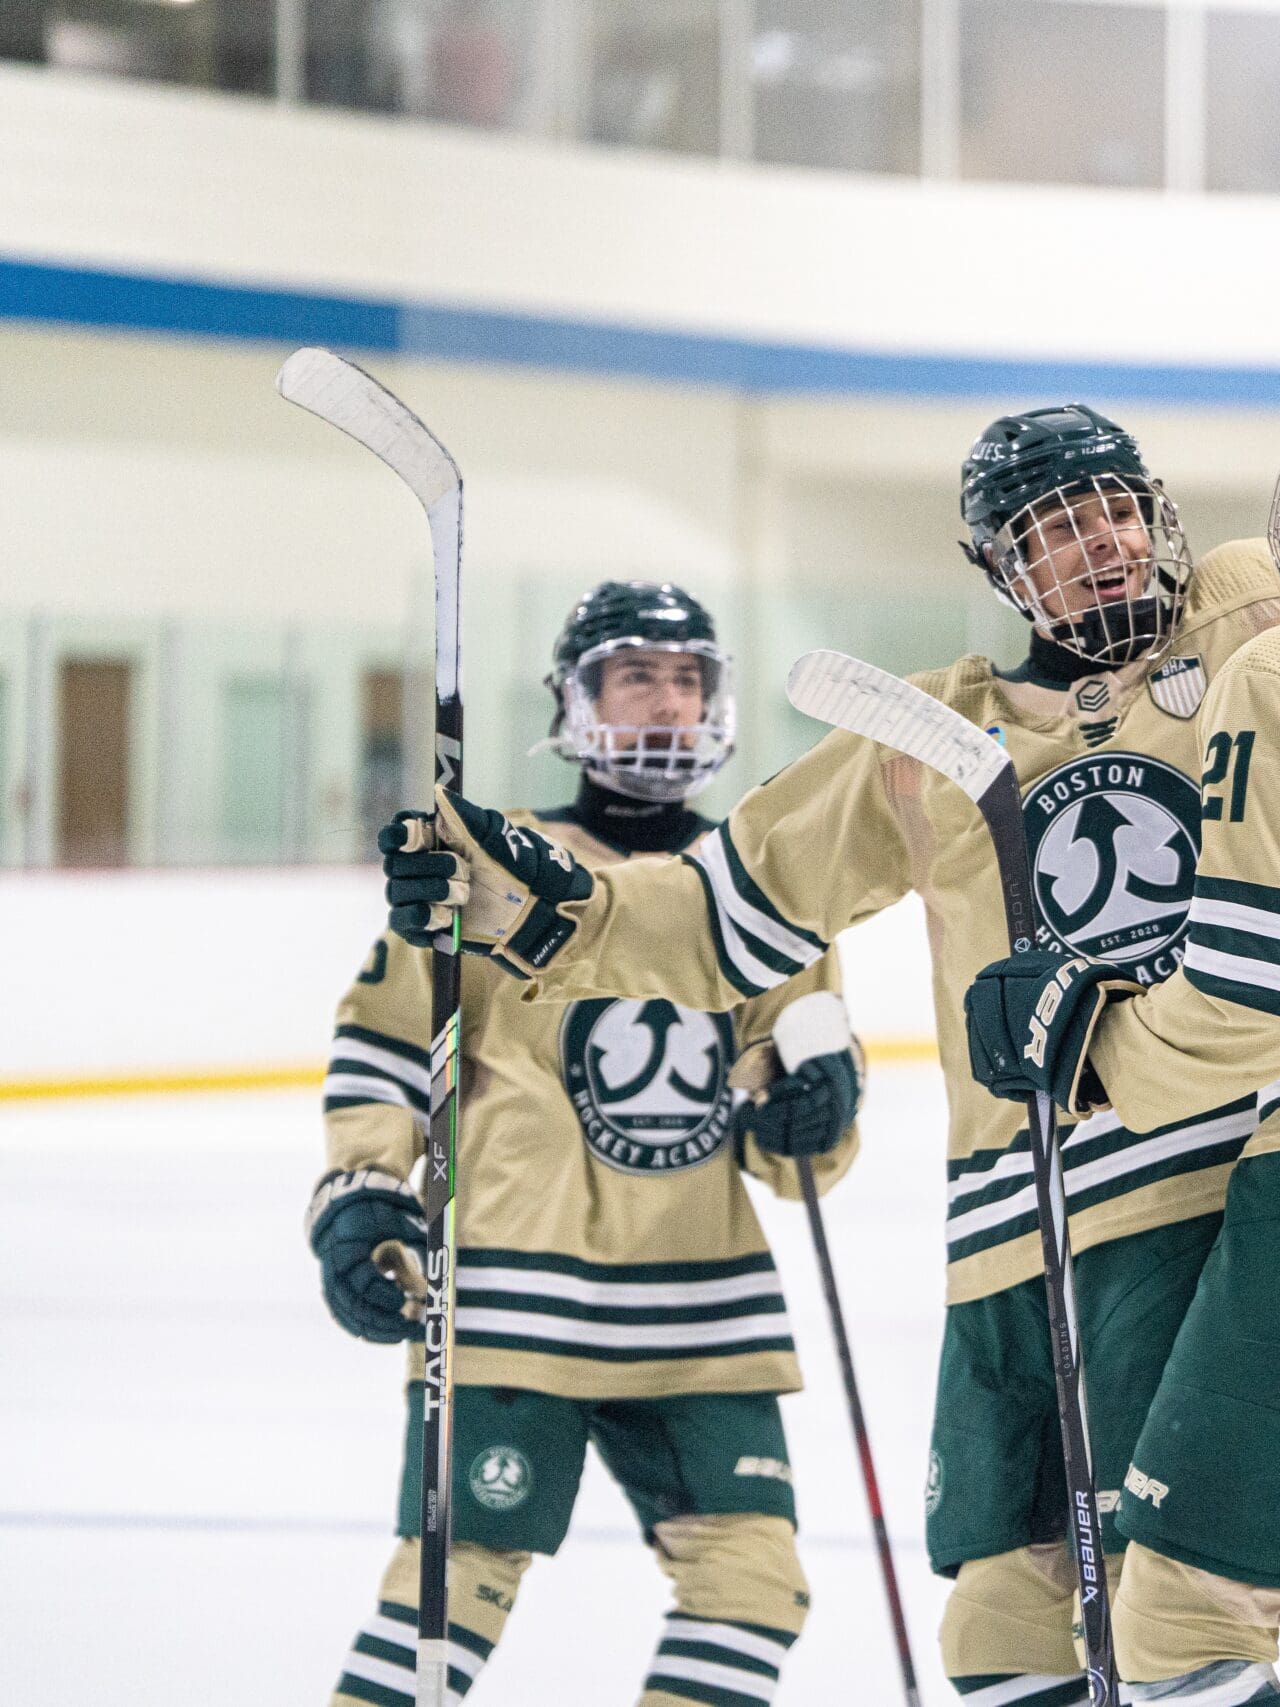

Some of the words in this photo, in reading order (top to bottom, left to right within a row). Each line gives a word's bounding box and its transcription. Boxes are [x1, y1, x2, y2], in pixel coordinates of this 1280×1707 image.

[1161, 660, 1187, 677] BHA
[1036, 764, 1145, 815] BOSTON
[1201, 730, 1256, 823] 21
[1100, 934, 1125, 948] EST.
[574, 1089, 642, 1165] HOCKEY
[432, 1141, 448, 1182] XF
[424, 1244, 450, 1422] TACKS
[1075, 1490, 1097, 1583] BAUER
